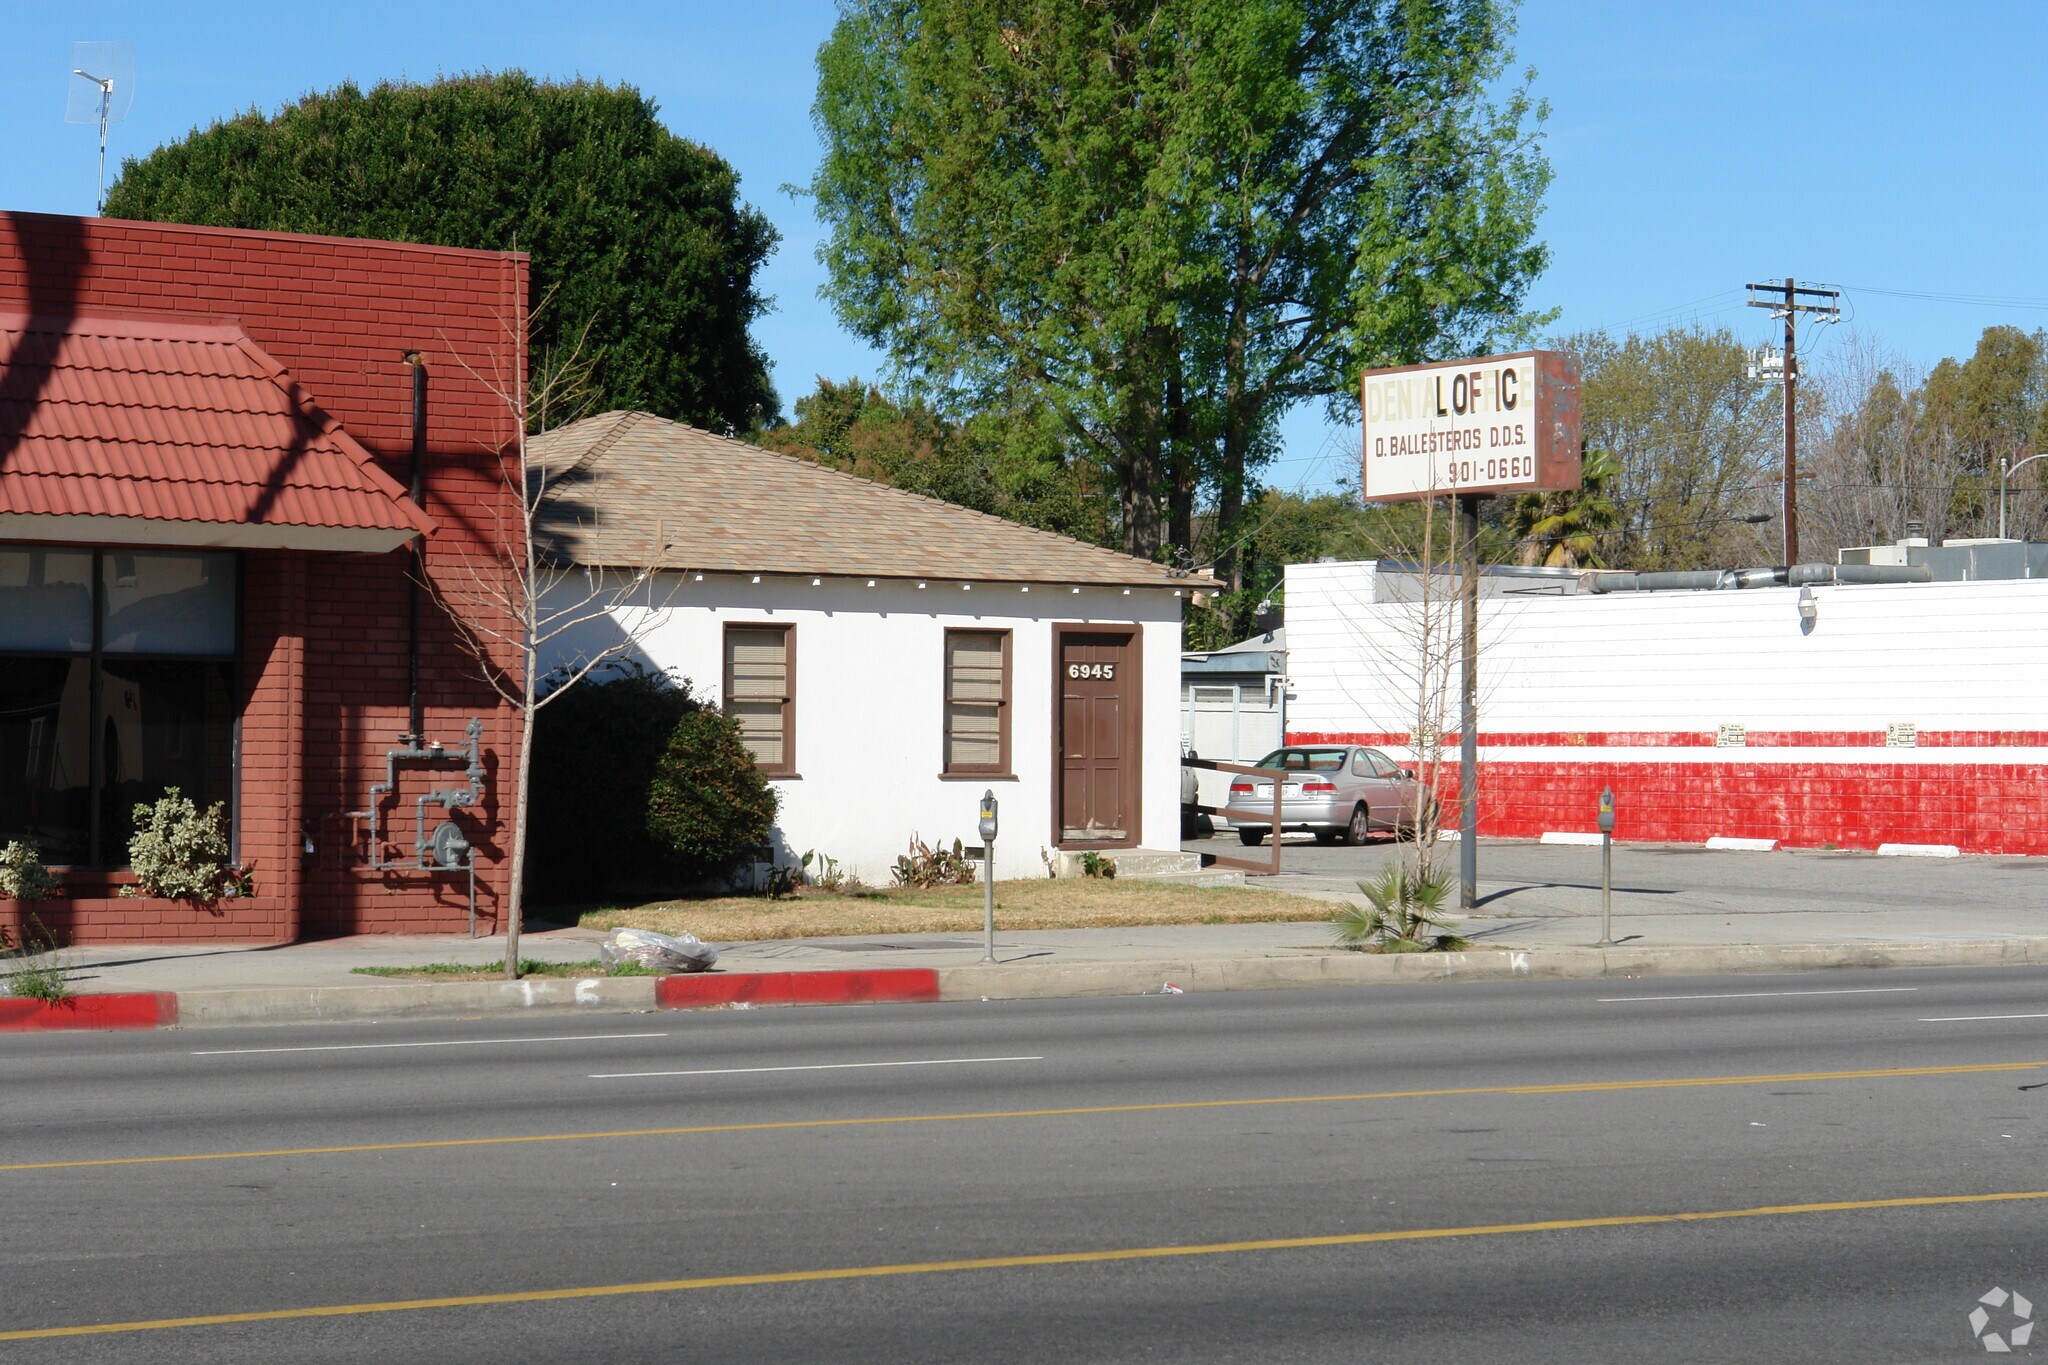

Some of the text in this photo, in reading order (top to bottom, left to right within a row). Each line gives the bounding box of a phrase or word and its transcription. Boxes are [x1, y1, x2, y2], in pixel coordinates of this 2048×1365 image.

[1452, 366, 1533, 416] OFFICE
[1375, 424, 1526, 458] O. BALLESTEROS D.D.S.
[1449, 455, 1532, 483] 901-0660
[1068, 664, 1113, 679] 6945
